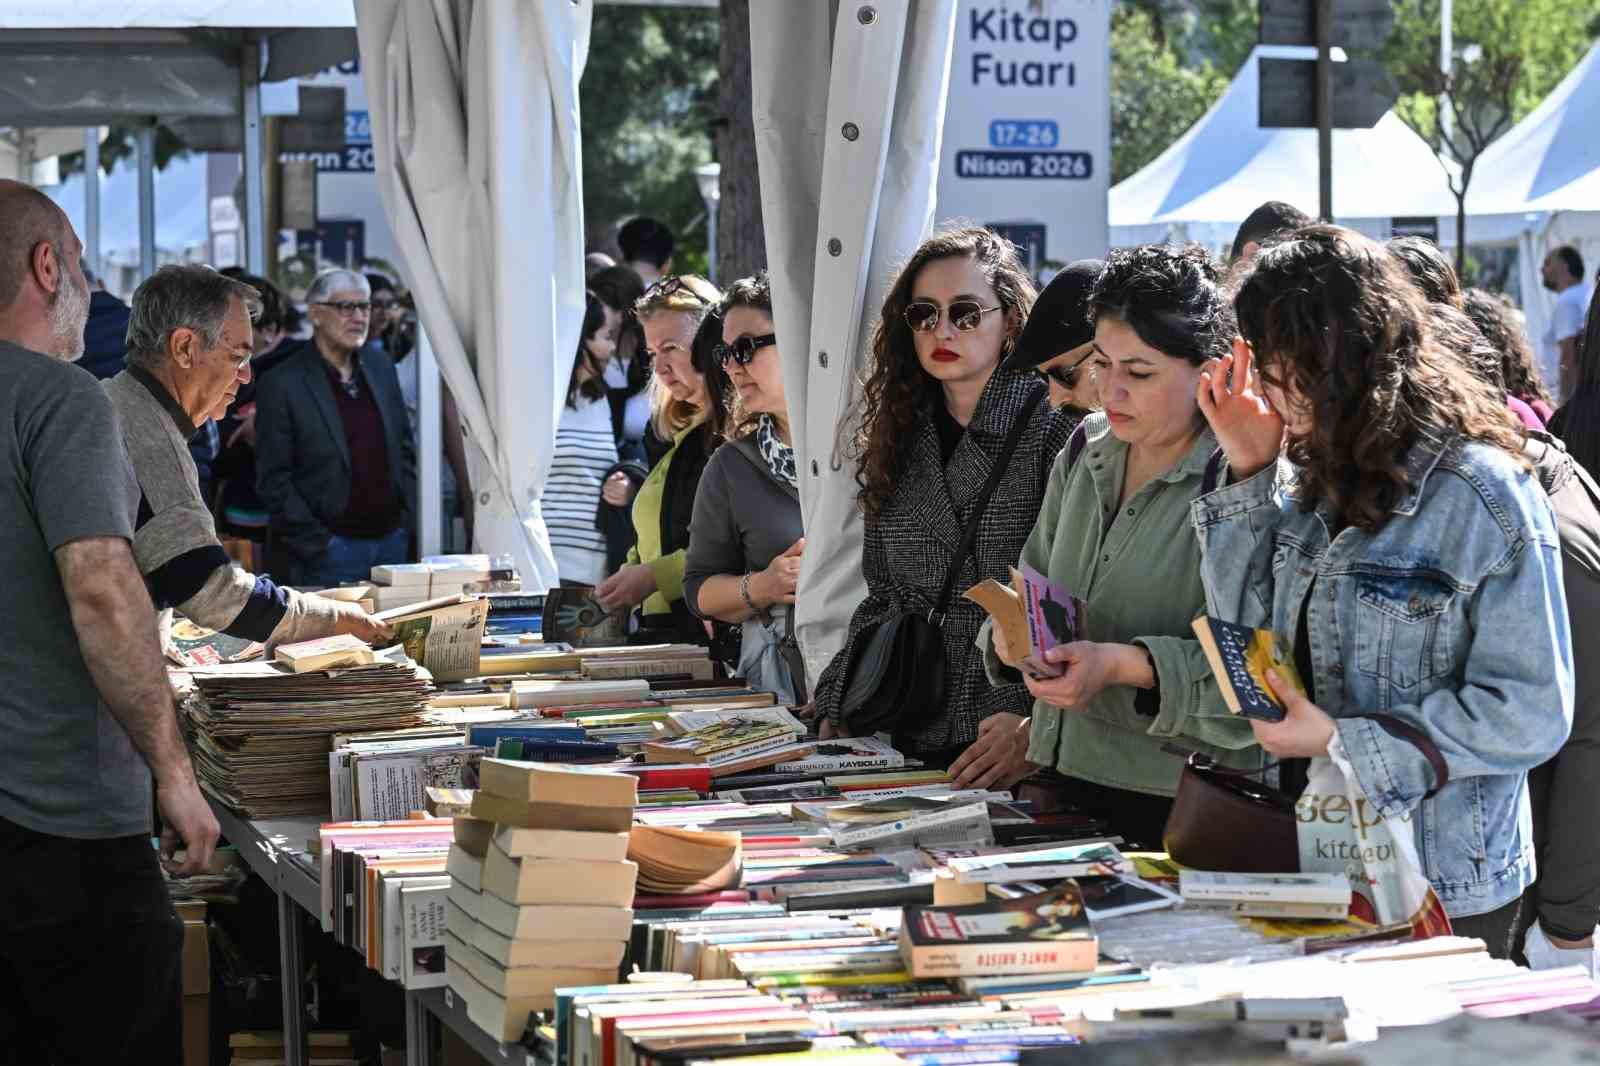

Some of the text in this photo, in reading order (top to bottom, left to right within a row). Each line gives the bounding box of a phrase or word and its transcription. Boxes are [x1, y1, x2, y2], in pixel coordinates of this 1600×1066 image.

[969, 8, 1078, 51] Kitap
[971, 54, 1076, 87] Fuarı
[994, 123, 1055, 146] 17-26
[961, 155, 1086, 177] Nisan 2026
